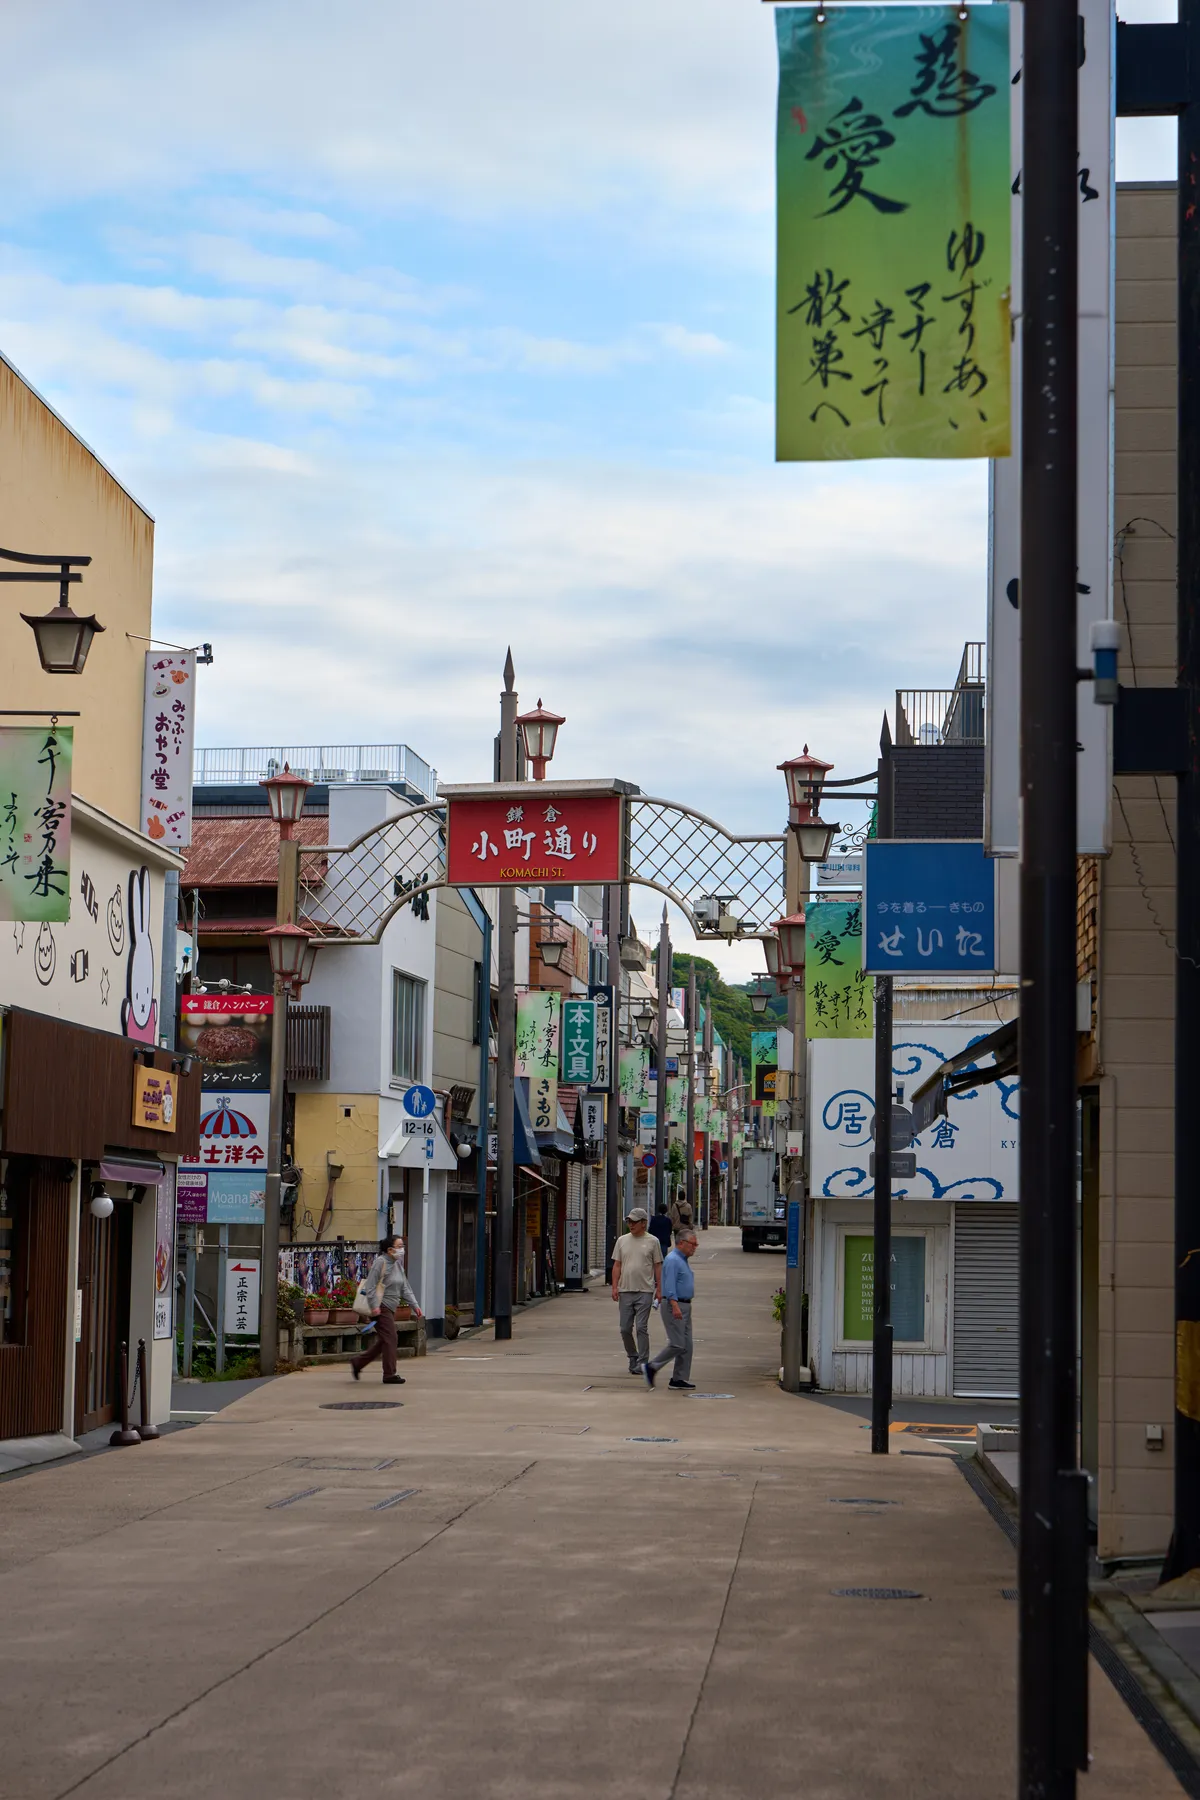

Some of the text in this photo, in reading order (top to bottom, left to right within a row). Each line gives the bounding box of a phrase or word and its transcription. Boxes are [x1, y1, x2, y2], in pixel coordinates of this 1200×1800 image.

[787, 268, 852, 428] 散策へ
[171, 699, 186, 755] みっふぃー
[150, 712, 172, 790] おやつ堂
[24, 736, 68, 897] 千客万来
[506, 804, 562, 823] 鎌倉
[471, 825, 598, 861] 小町通り
[500, 868, 565, 878] KOMACHI ST.
[878, 925, 986, 957] せいた
[536, 1079, 551, 1128] きもの
[405, 1122, 433, 1133] 12-16
[210, 1190, 248, 1204] Moana
[236, 1276, 248, 1330] 正宗工芸
